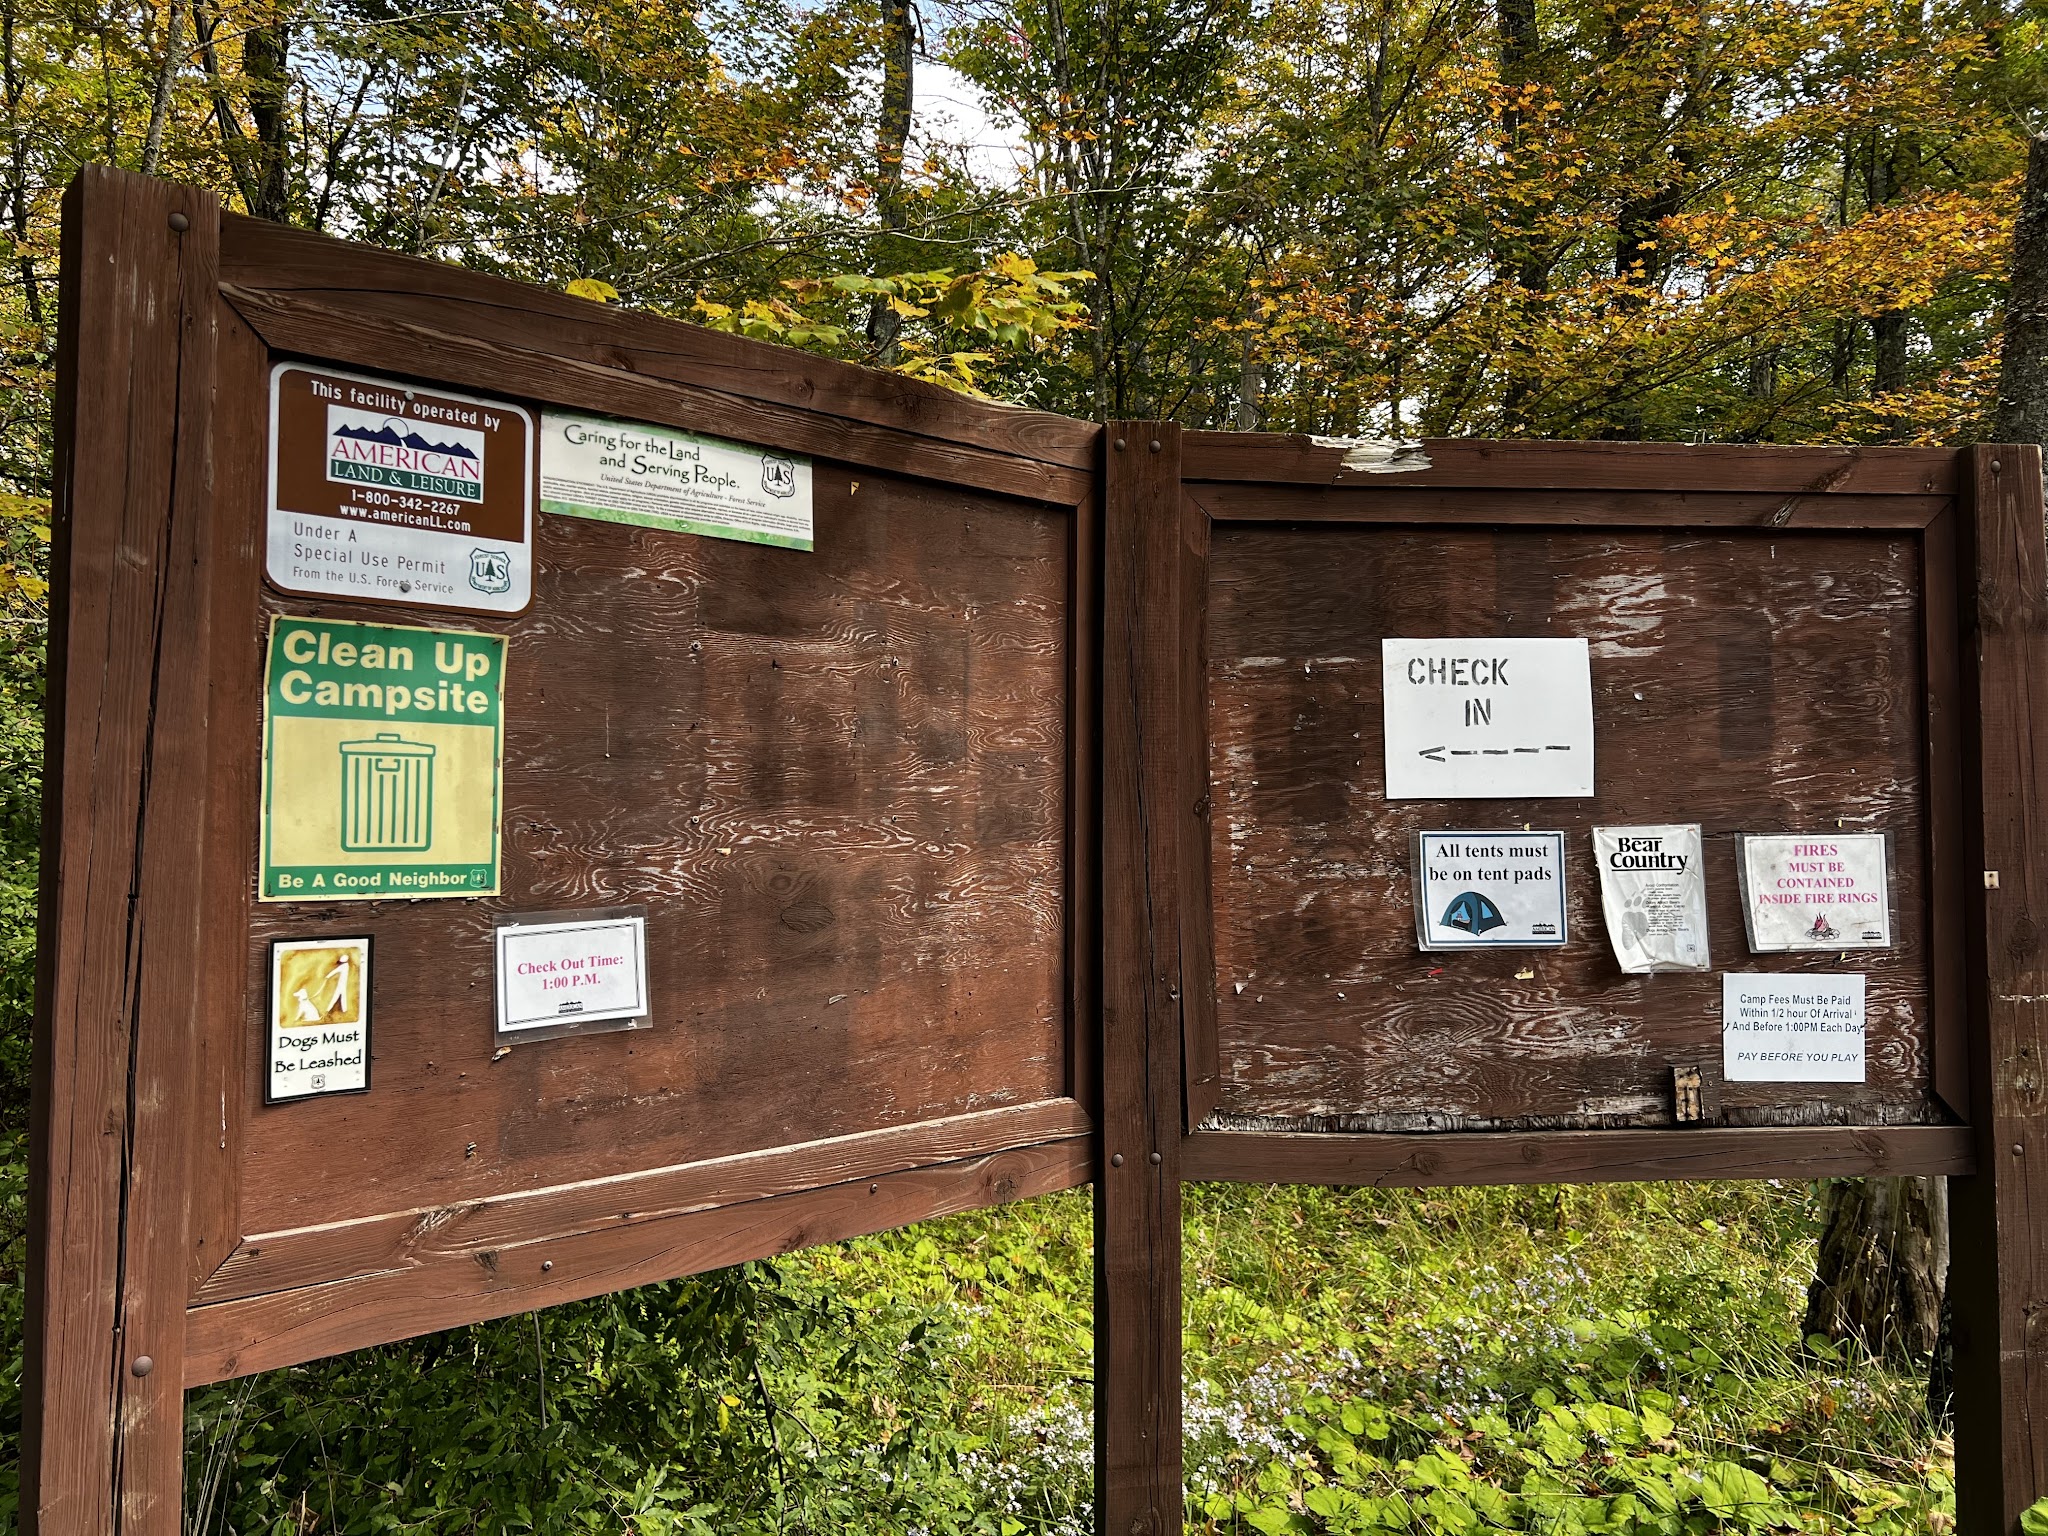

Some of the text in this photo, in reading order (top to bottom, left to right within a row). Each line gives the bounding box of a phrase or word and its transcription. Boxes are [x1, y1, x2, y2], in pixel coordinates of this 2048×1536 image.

[311, 380, 501, 432] This facility operated by
[564, 424, 700, 461] Caring for the Land
[331, 437, 480, 480] AMERICAN
[334, 461, 476, 497] LAND & LEISURE
[600, 454, 626, 468] and
[631, 455, 690, 484] Serving
[695, 464, 740, 492] People.
[600, 473, 624, 484] United
[624, 477, 643, 487] States
[644, 480, 682, 494] Department
[682, 486, 690, 496] of
[689, 487, 724, 501] Agriculture
[729, 494, 746, 503] Forest
[746, 498, 766, 508] Service
[351, 489, 460, 516] 1-800-342-2267
[340, 505, 471, 532] www.americanLL.com
[294, 522, 357, 542] Under A
[294, 544, 446, 574] Special Use Permit
[293, 566, 321, 579] From
[326, 570, 344, 582] the
[350, 573, 371, 586] U.S.
[415, 579, 454, 594] Service
[283, 630, 490, 682] Clean Up
[1408, 657, 1509, 686] CHECK
[279, 670, 489, 715] Campsite
[1465, 698, 1491, 727] IN
[1436, 844, 1549, 858] All tents must
[1618, 837, 1663, 853] Bear
[1794, 844, 1838, 857] FIRES
[1610, 852, 1689, 875] Country
[1789, 862, 1845, 873] MUST BE
[278, 869, 468, 888] Be A Good Neighbor
[1429, 866, 1552, 884] be on tent pads
[1777, 878, 1854, 889] CONTAINED
[1759, 893, 1878, 905] INSIDE FIRE RINGS
[517, 956, 624, 975] Check Out Time:
[542, 973, 601, 990] 1:00 P.M.
[1740, 994, 1851, 1006] Camp Fees Must Be Paid
[1740, 1008, 1852, 1018] Within 1/2 hour Of Arrival
[1732, 1022, 1750, 1031] And
[1753, 1022, 1782, 1032] Before
[1786, 1022, 1818, 1032] 1:00PM
[1820, 1022, 1842, 1032] Each
[279, 1030, 360, 1052] Dogs Must
[275, 1049, 361, 1073] Be Leashed
[1738, 1052, 1858, 1062] PAY BEFORE YOU PLAY
